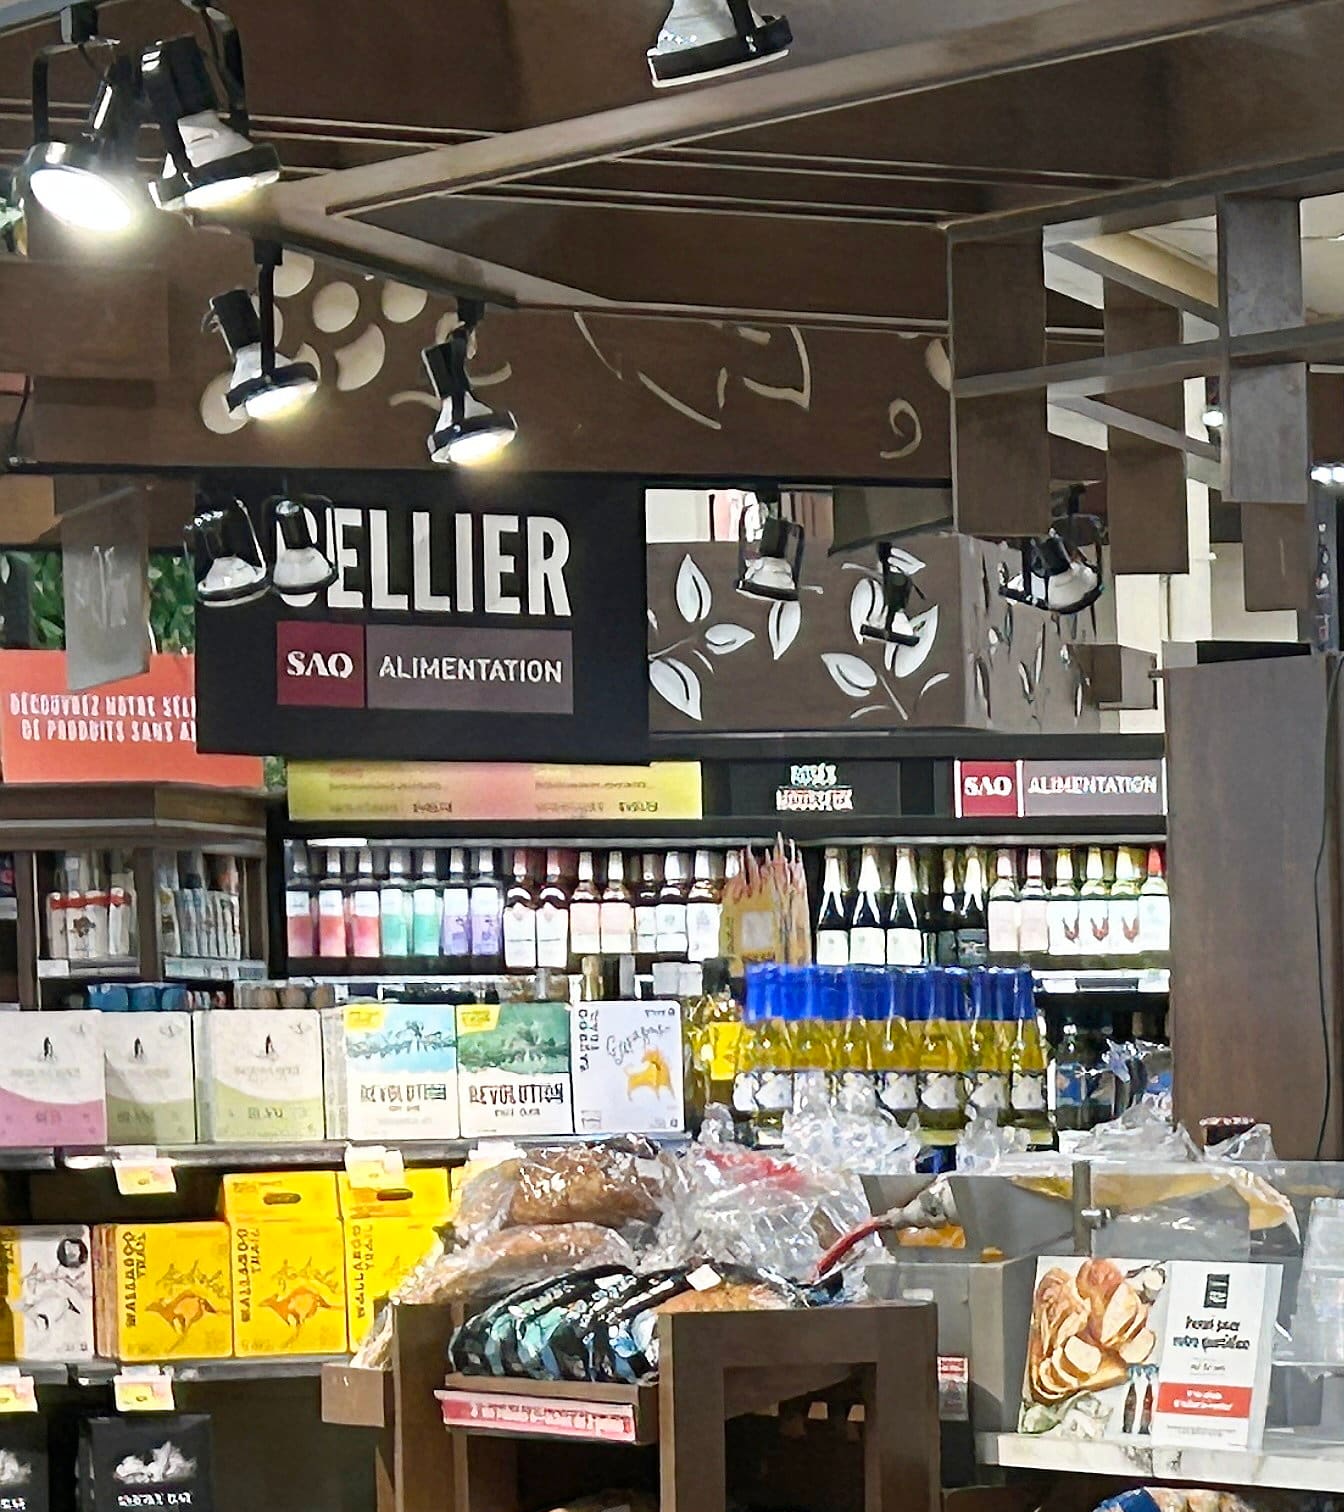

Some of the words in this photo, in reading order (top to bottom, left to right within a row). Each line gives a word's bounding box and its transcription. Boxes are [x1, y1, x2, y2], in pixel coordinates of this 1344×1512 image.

[287, 651, 353, 678] SAQ
[379, 656, 562, 684] ALIMENTATION
[21, 718, 41, 742] DE
[48, 720, 125, 743] PRODUITS
[131, 721, 174, 743] SANS
[964, 776, 1013, 797] SAQ
[1027, 775, 1158, 795] ALIMENTATION
